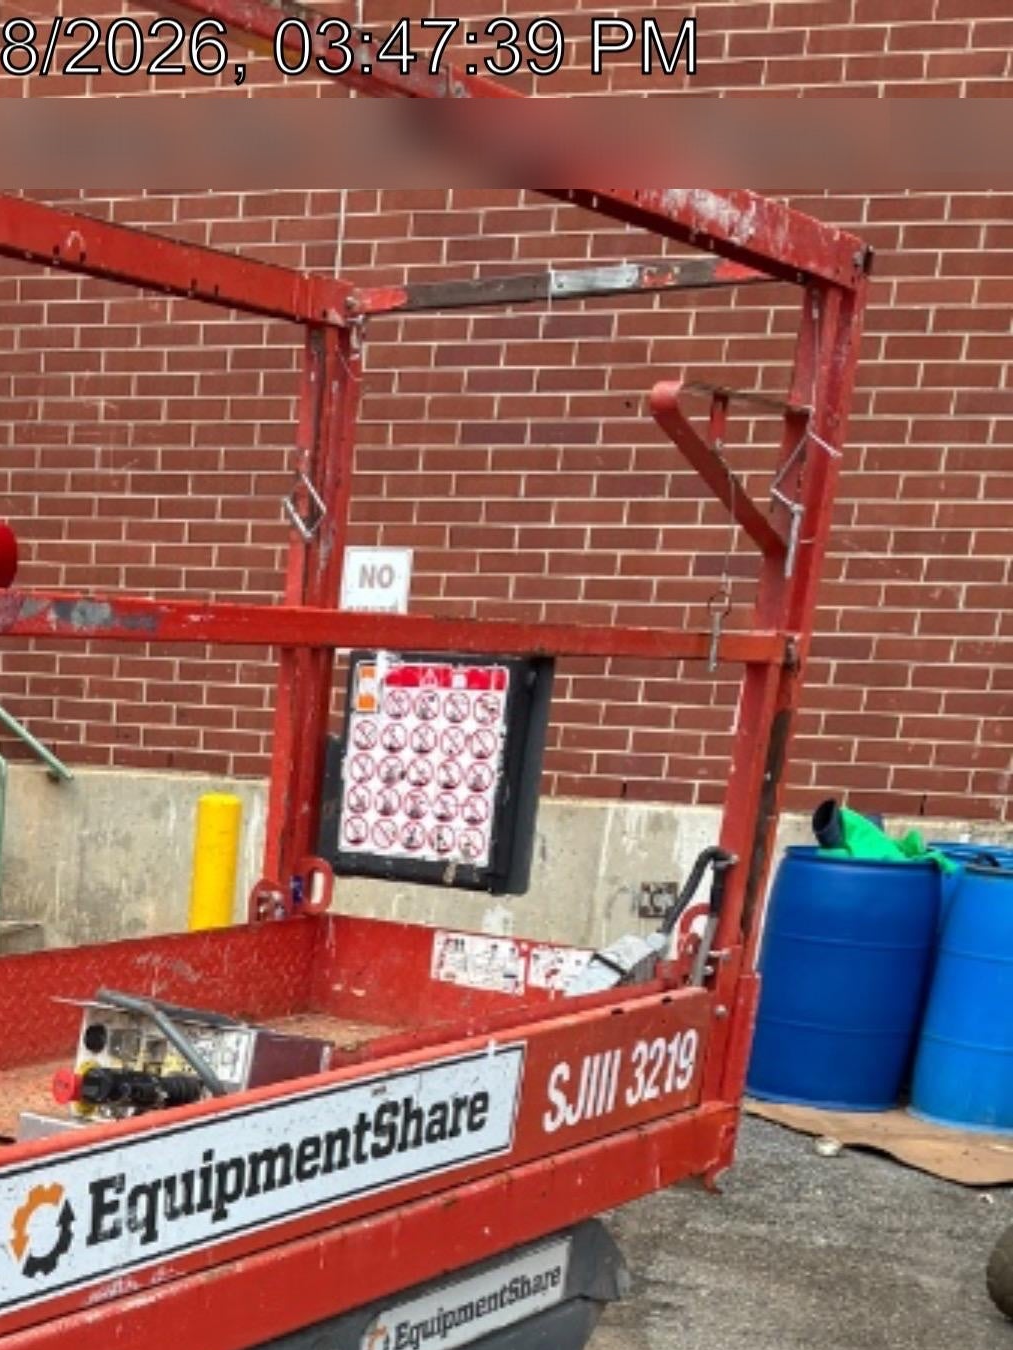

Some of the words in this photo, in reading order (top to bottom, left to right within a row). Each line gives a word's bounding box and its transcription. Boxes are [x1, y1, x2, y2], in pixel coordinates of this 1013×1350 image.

[358, 563, 396, 589] NO
[625, 1028, 699, 1108] 3219
[86, 1091, 490, 1246] EquipmentShare
